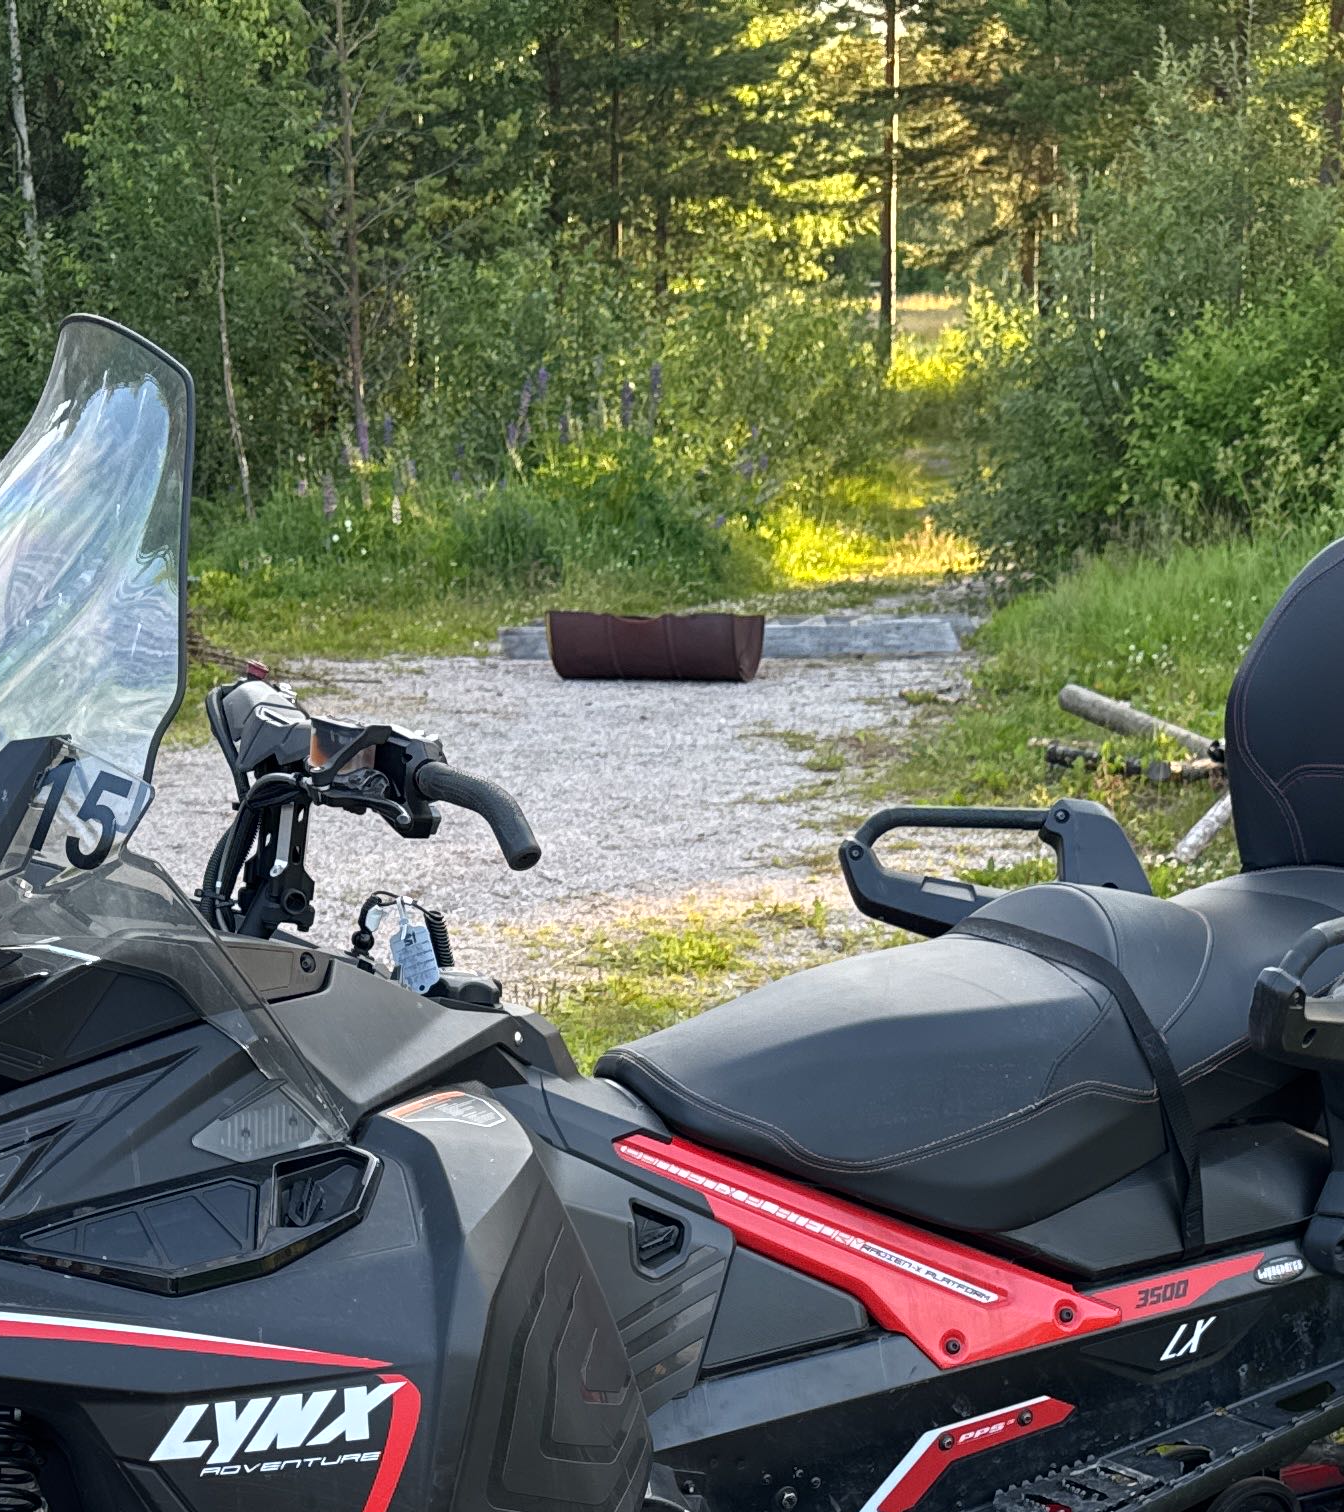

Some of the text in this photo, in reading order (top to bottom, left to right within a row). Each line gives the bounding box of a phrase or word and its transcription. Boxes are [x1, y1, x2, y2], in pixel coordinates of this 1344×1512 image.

[29, 756, 133, 870] 15
[925, 1270, 991, 1302] PLATFORM
[1136, 1279, 1189, 1309] 3500
[1159, 1316, 1217, 1361] LX
[149, 1381, 408, 1465] LYNX
[199, 1451, 381, 1478] ADVENTURE
